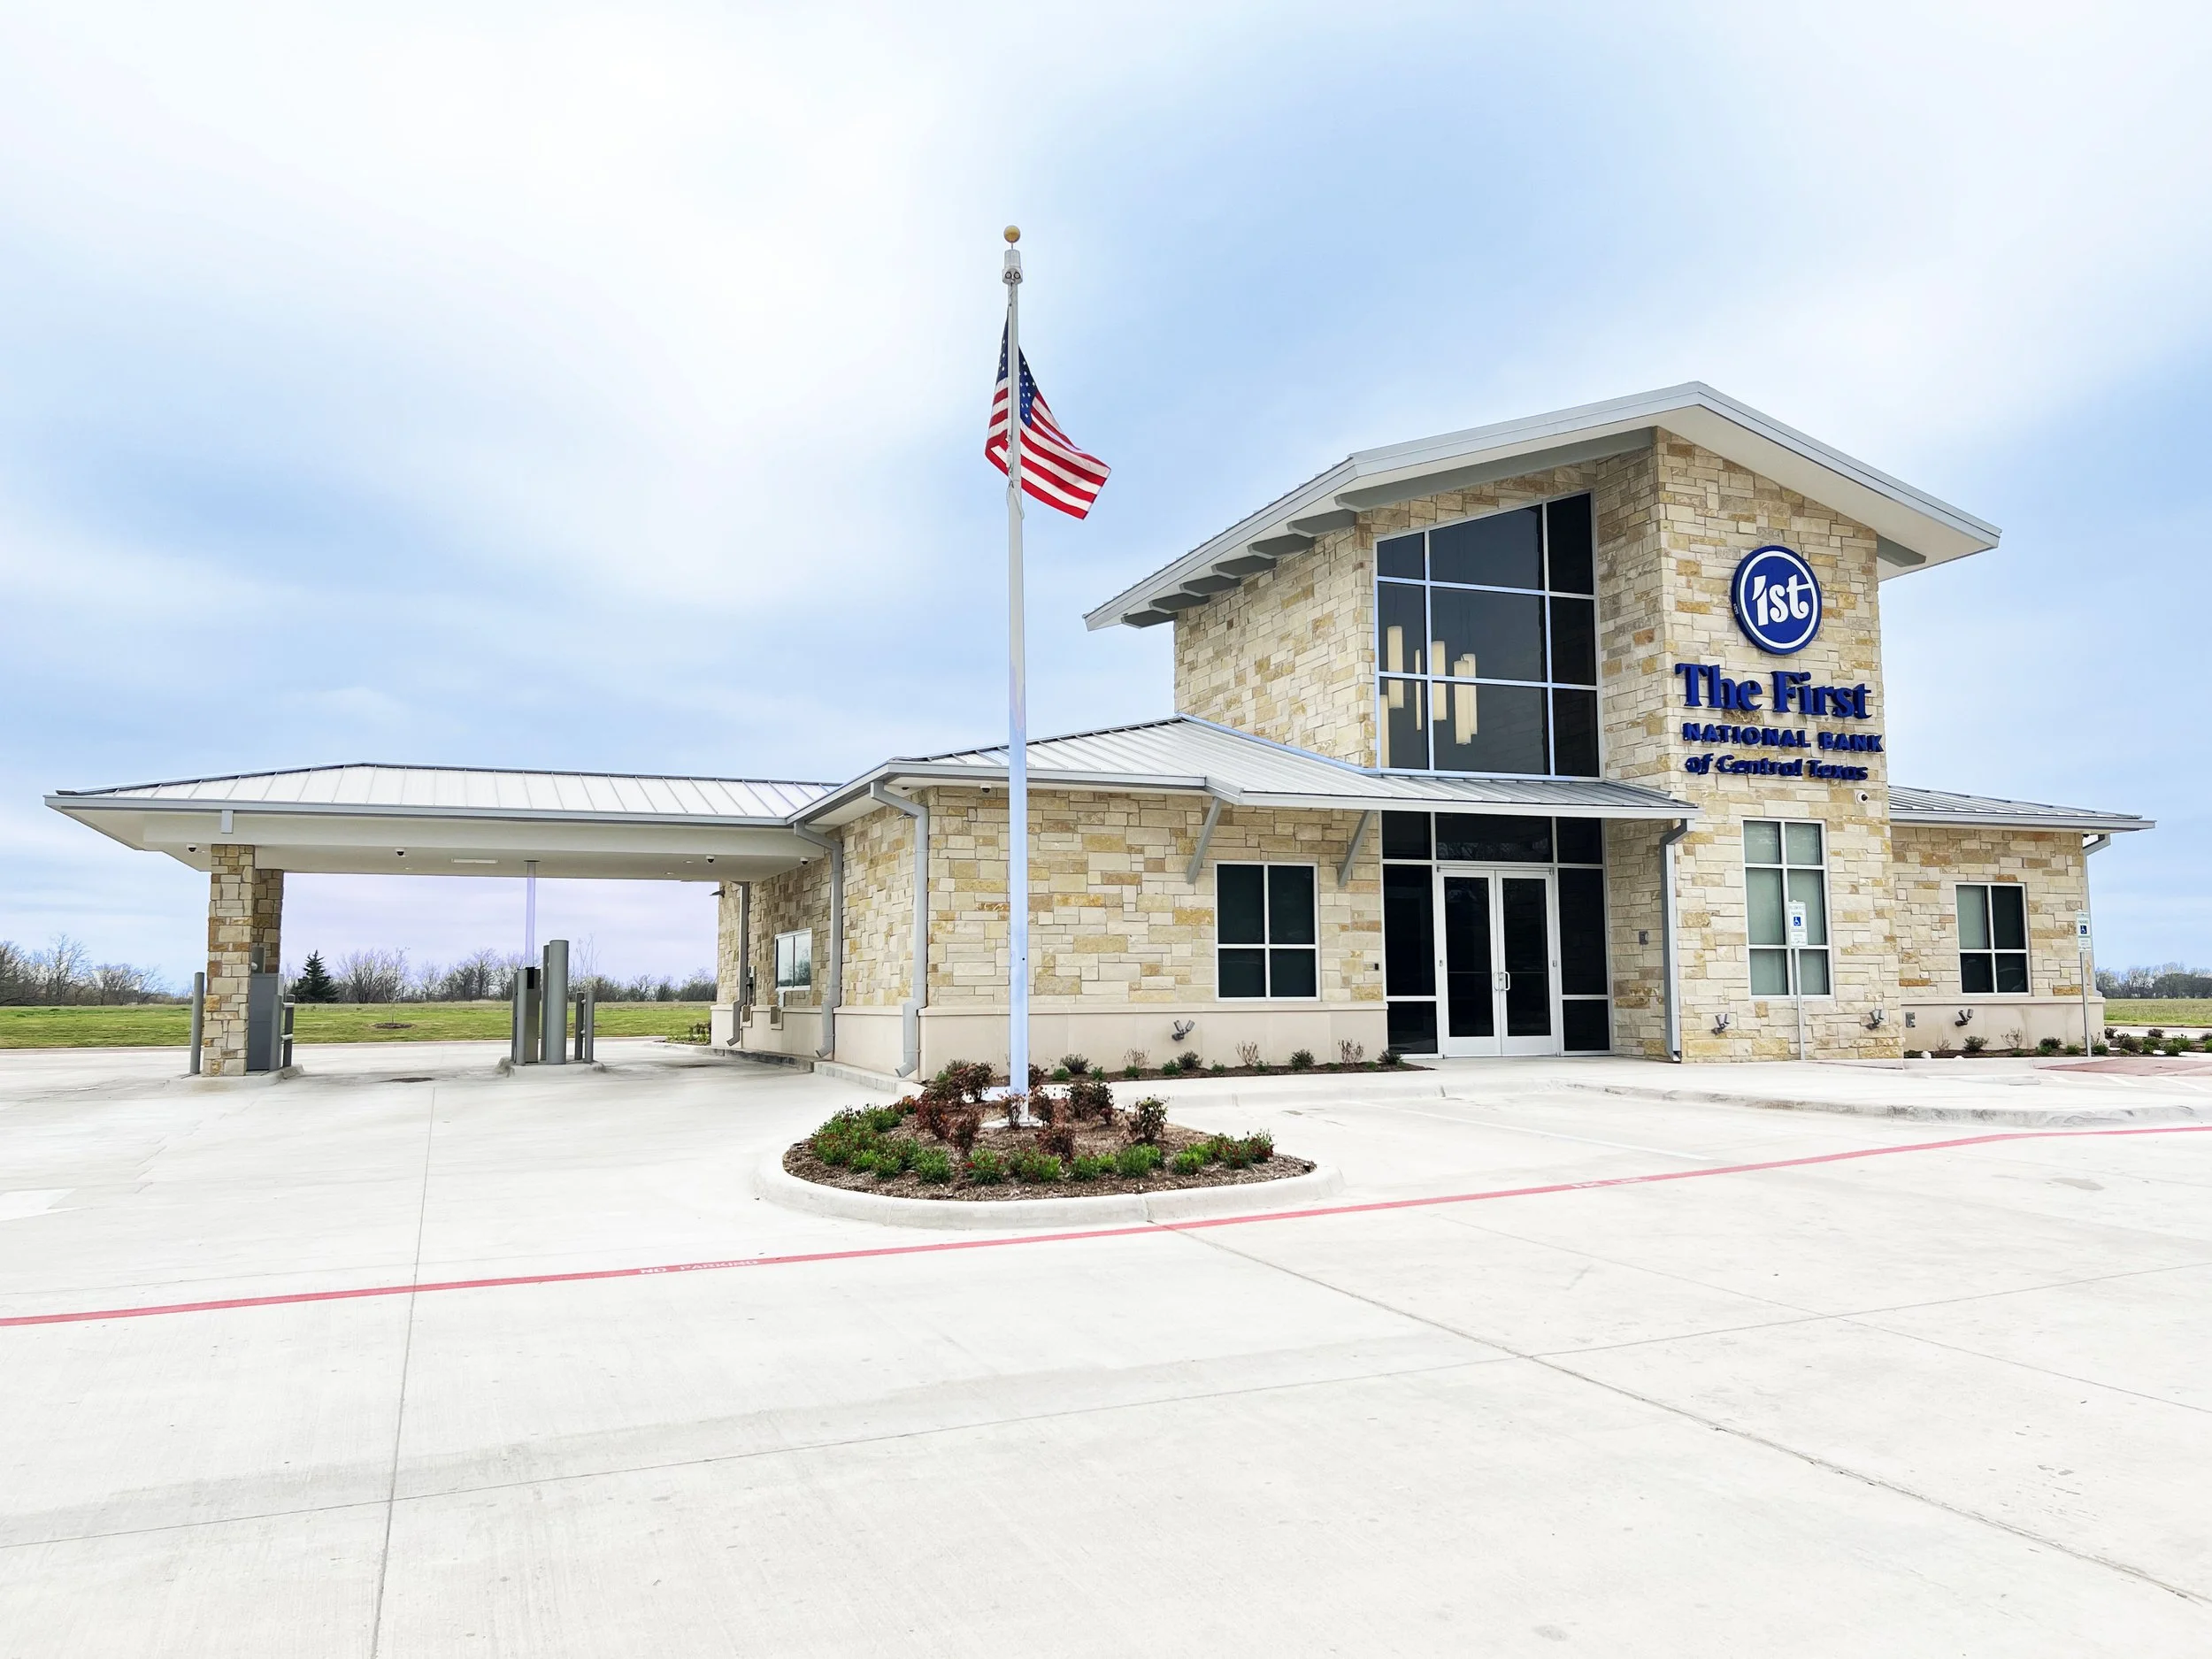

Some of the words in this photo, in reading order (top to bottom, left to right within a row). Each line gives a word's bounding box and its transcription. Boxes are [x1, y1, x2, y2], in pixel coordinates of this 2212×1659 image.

[1752, 574, 1810, 626] 1st
[1675, 663, 1763, 711] The
[1770, 671, 1872, 719] First
[1683, 722, 1811, 748] NATIONAL
[1817, 732, 1884, 752] BANK
[1685, 753, 1714, 775] of
[1715, 754, 1803, 776] Central
[1806, 760, 1868, 780] Texas
[679, 1259, 759, 1271] PARKING
